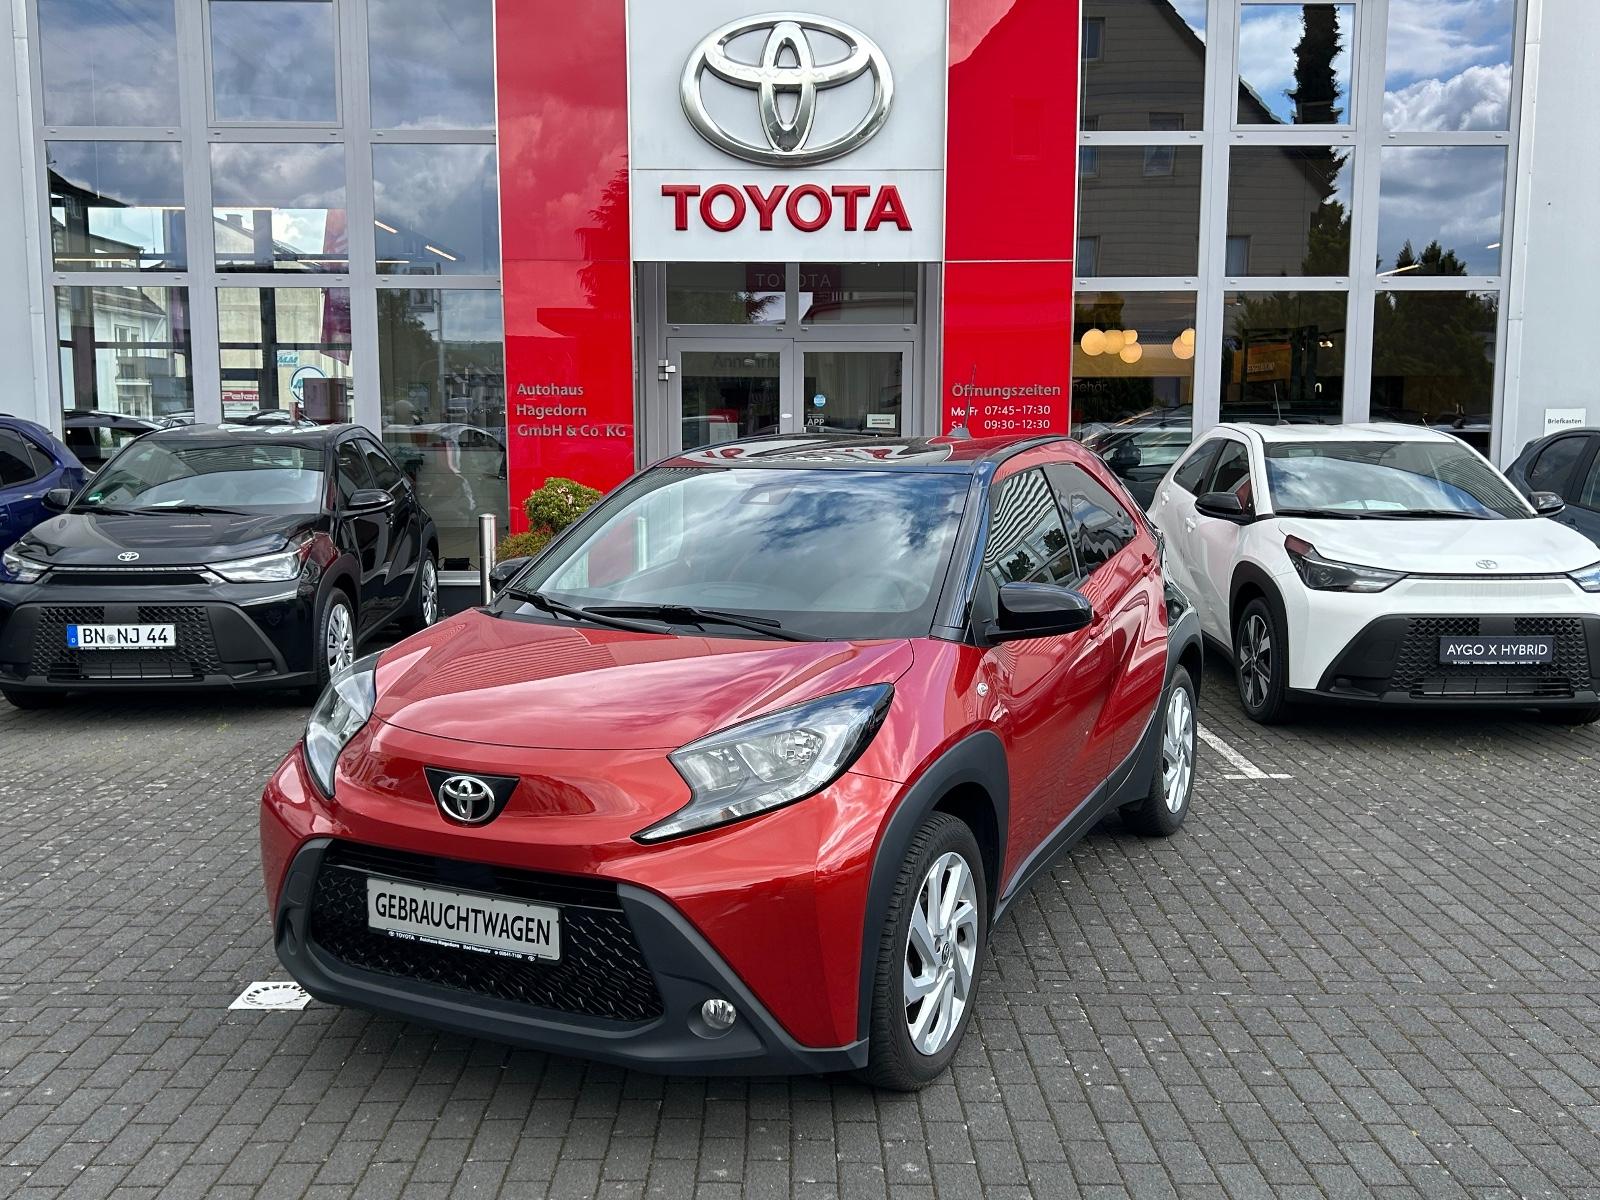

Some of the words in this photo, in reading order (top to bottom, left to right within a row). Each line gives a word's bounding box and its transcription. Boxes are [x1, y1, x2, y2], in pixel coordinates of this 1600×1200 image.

[661, 184, 913, 233] TOYOTA
[755, 273, 831, 288] TOOTA
[516, 383, 584, 396] Autohaus
[951, 383, 1061, 400] Öffnungszeiten
[516, 403, 587, 419] Hagedorn
[984, 405, 1051, 415] 07:45-17:30
[807, 418, 825, 426] APP
[984, 419, 1050, 429] 09:30-12:30
[1547, 417, 1582, 425] Briefkasten
[517, 424, 562, 437] GmbH
[566, 424, 577, 437] &
[606, 424, 626, 437] KG
[82, 628, 106, 644] BN
[117, 628, 140, 644] NJ
[146, 628, 169, 643] 44
[1447, 644, 1485, 655] AYGO
[1488, 644, 1497, 655] X
[1501, 644, 1548, 655] HYBRID
[375, 892, 551, 946] GEBRAUCHTWAGEN
[396, 932, 415, 940] TOYOTA
